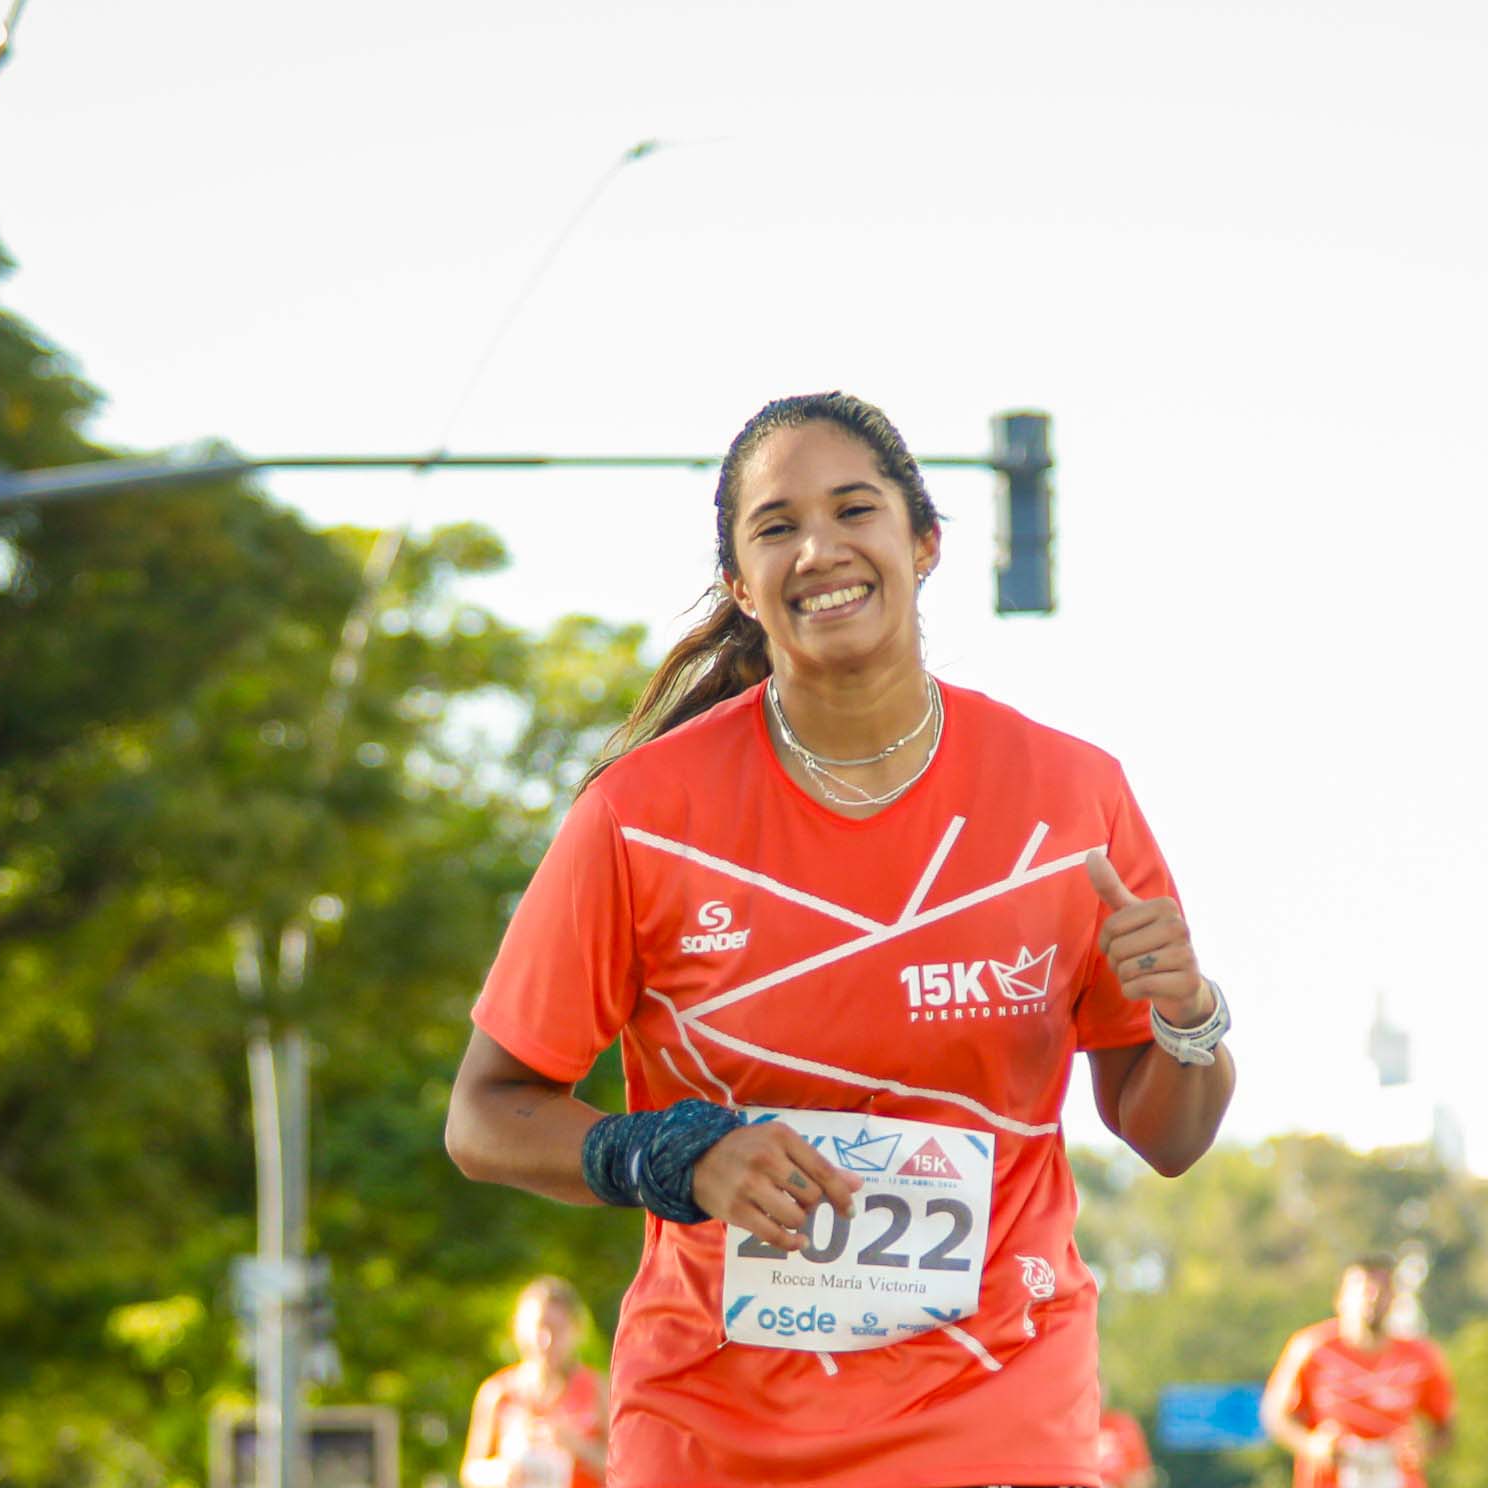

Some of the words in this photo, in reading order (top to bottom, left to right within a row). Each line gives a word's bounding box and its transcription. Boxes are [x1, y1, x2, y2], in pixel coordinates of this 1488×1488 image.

[900, 961, 990, 1007] 15K
[910, 1006, 990, 1023] PUERTO
[998, 1001, 1048, 1017] NORTE
[913, 1154, 948, 1173] 15K
[771, 1270, 815, 1287] Rocca
[820, 1273, 862, 1290] María
[869, 1277, 927, 1294] Victoria
[758, 1305, 837, 1336] osde
